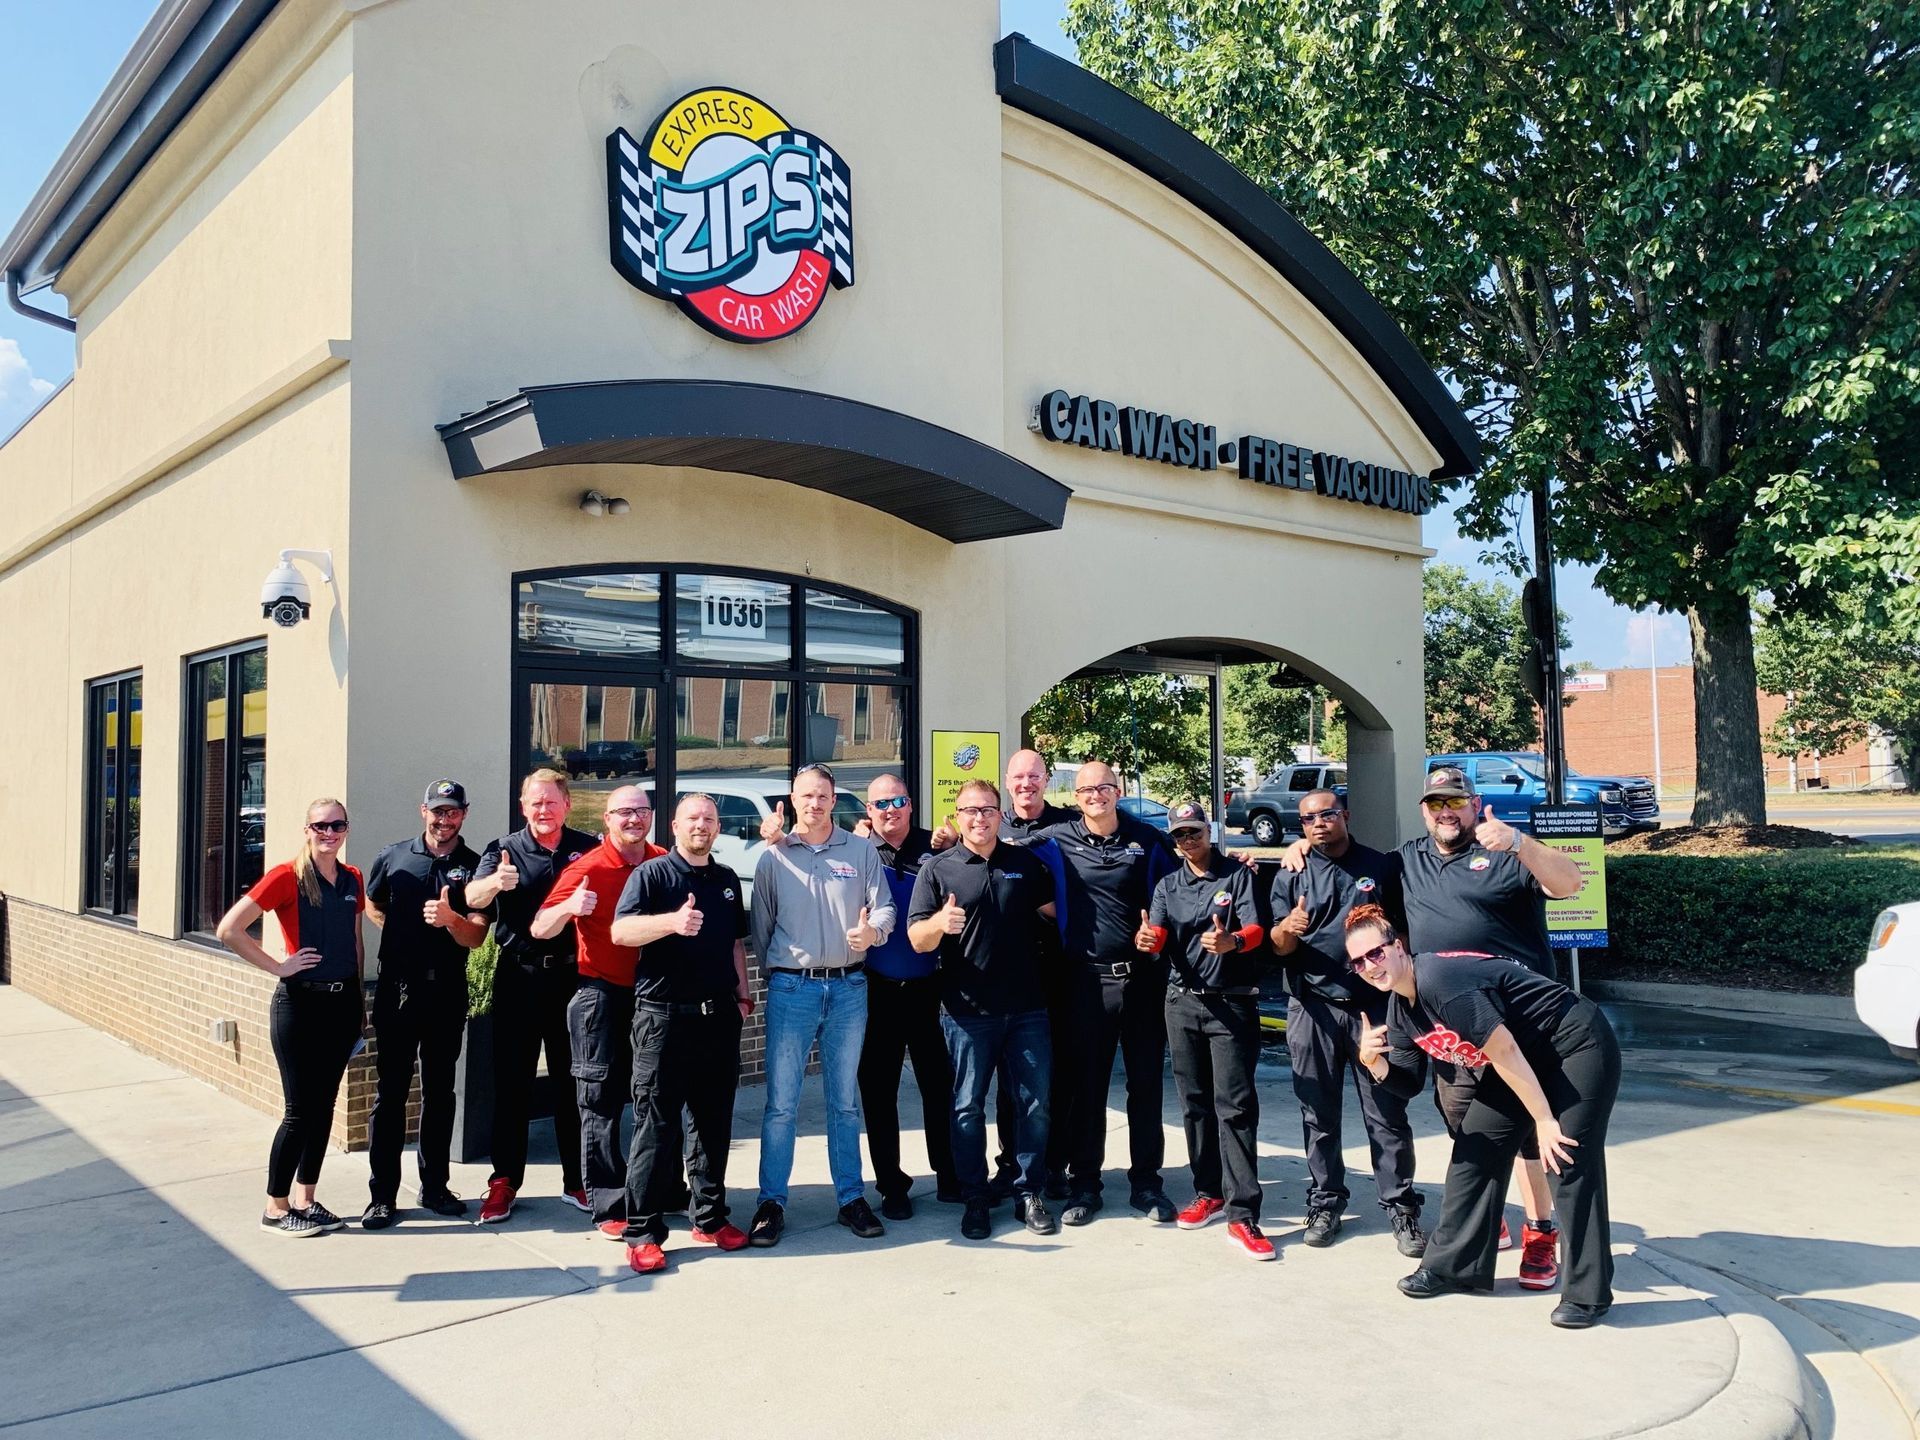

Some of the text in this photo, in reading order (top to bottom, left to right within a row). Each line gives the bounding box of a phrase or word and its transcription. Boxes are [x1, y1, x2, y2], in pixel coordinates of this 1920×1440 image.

[660, 98, 754, 157] EXPRESS
[662, 151, 816, 274] ZIPS
[718, 260, 823, 331] CAR WASH
[1042, 389, 1432, 516] CAR WASH FREE VACUUMS
[704, 595, 763, 629] 1036
